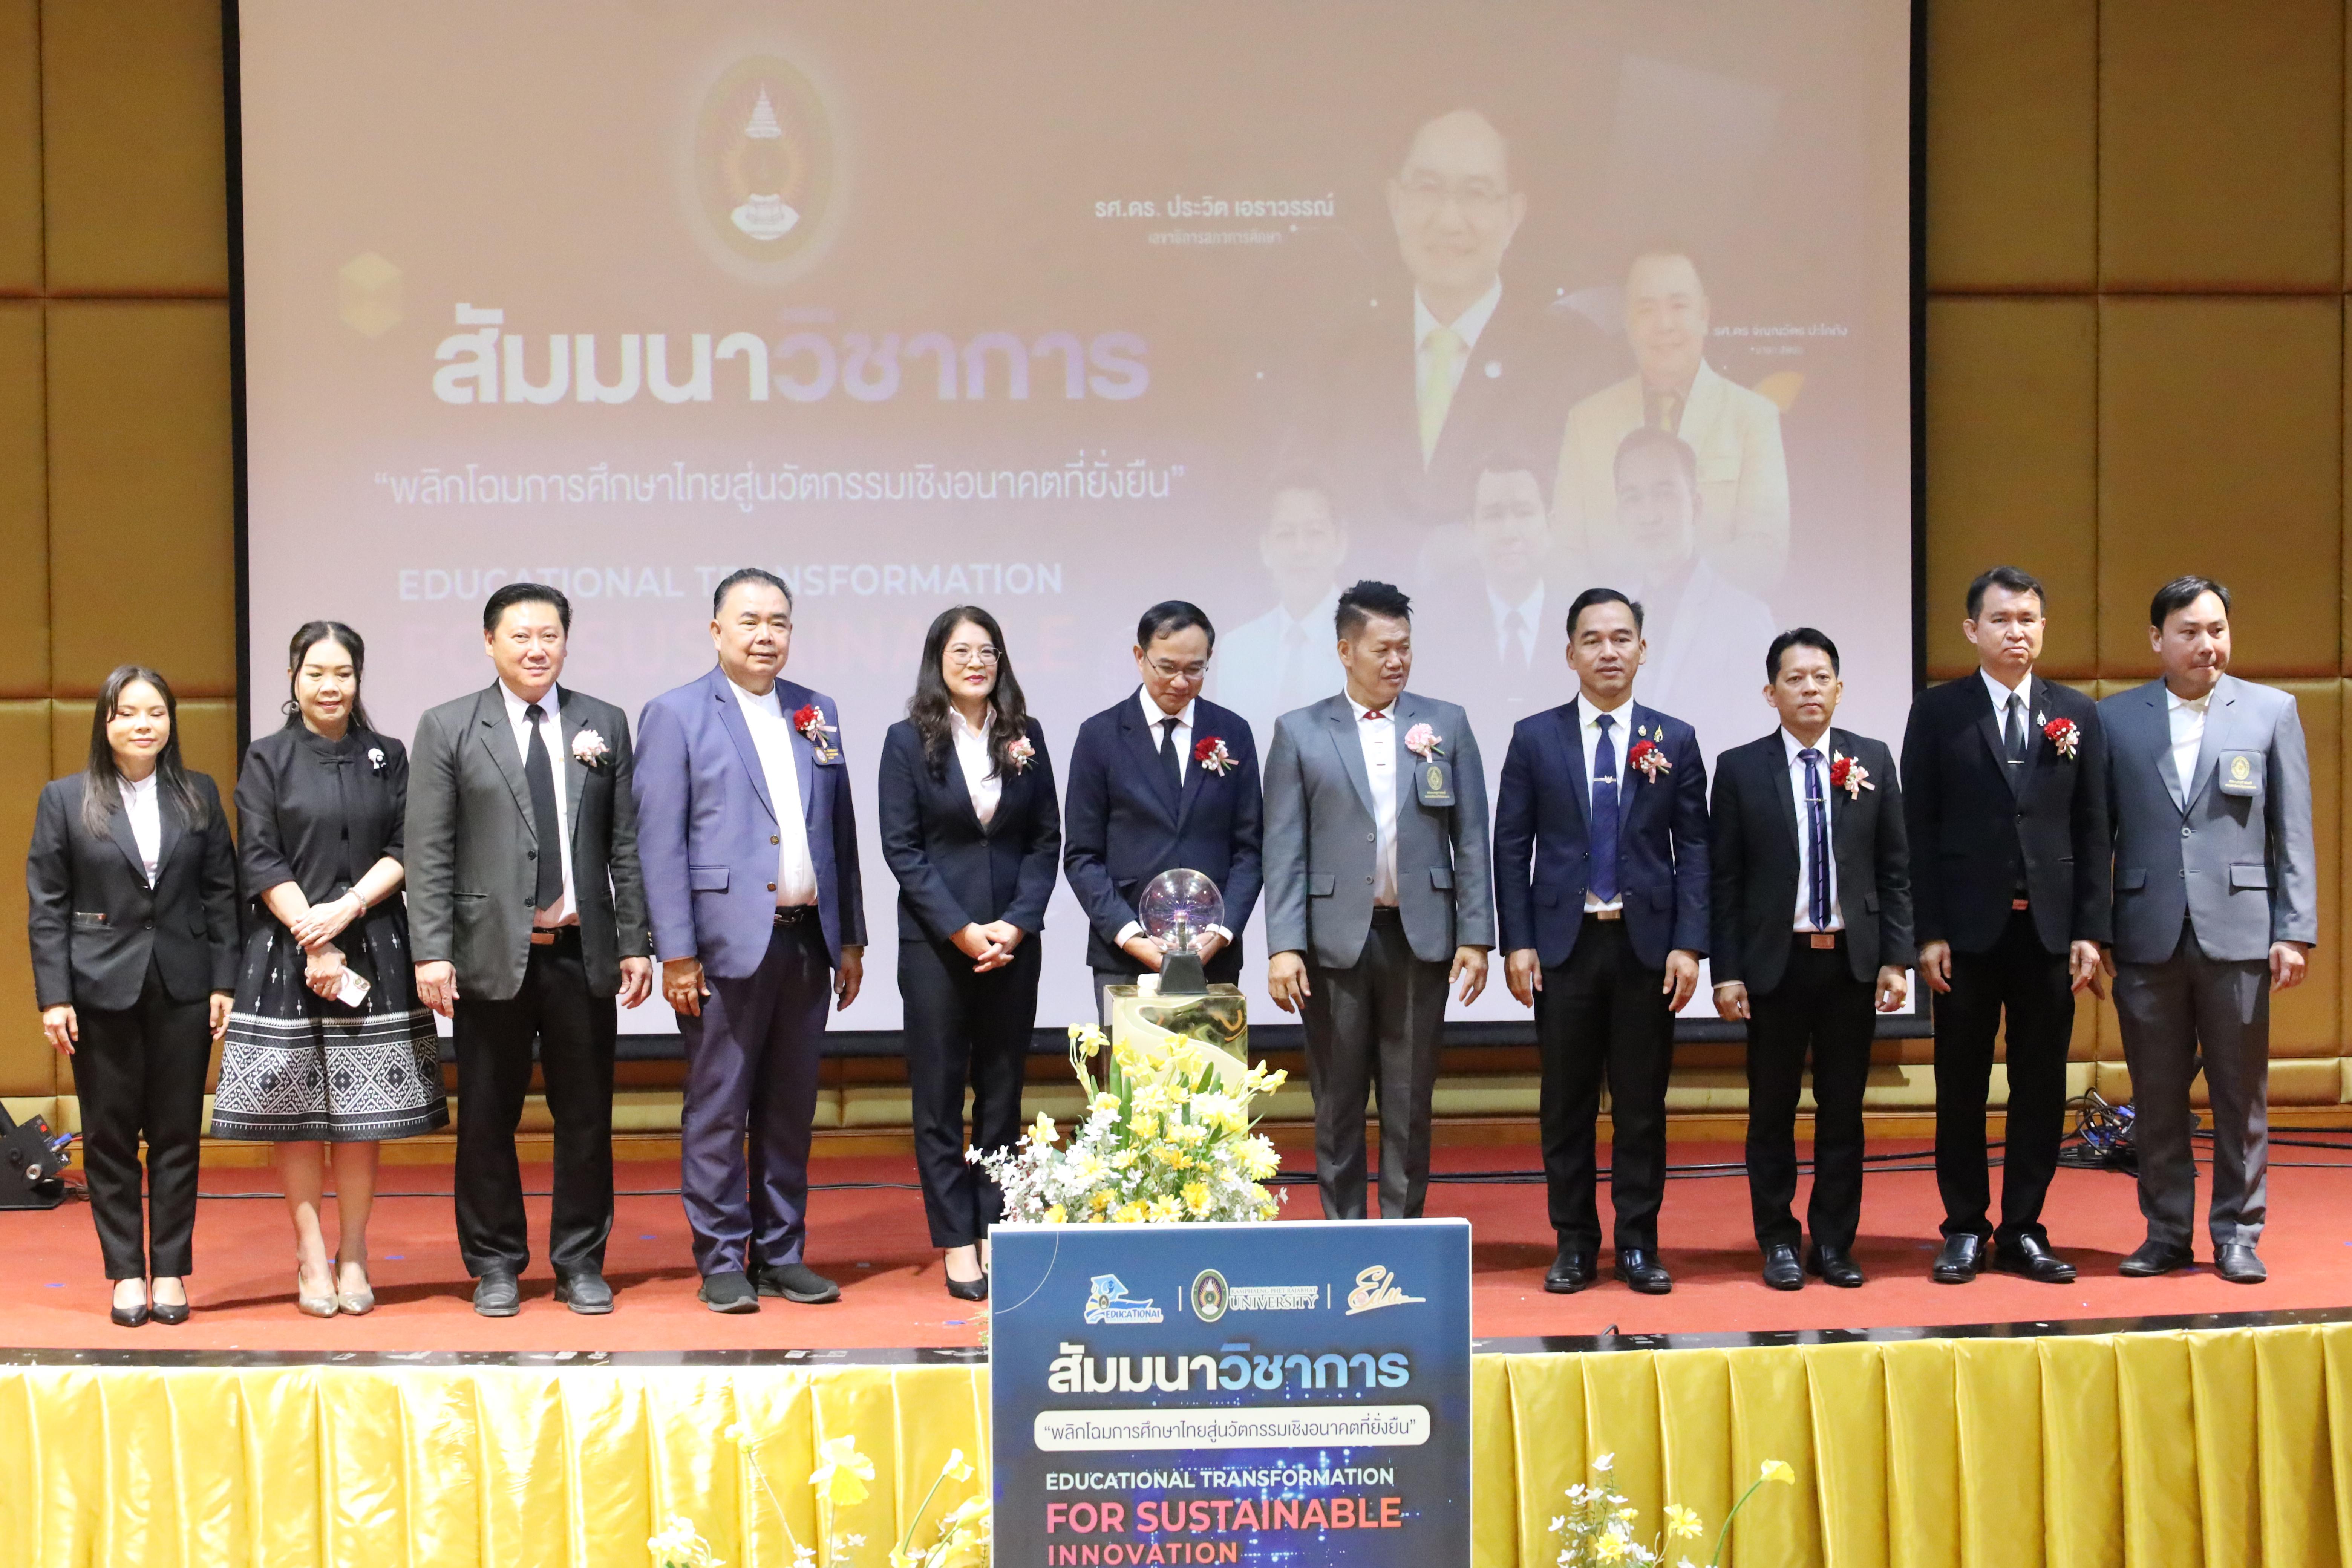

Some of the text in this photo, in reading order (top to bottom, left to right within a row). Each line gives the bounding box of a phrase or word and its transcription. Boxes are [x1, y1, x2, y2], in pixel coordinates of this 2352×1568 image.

[433, 303, 1150, 404] สัมมนาวิชาการ
[1230, 1296, 1317, 1309] UNIVERSITY
[1047, 1342, 1410, 1393] สัมมนาวิชาการ
[1046, 1467, 1394, 1491] EDUCATIONAL TRANSFORMATION
[1046, 1497, 1402, 1533] FOR SUSTAINABLE
[1048, 1542, 1237, 1566] INNOVATION
